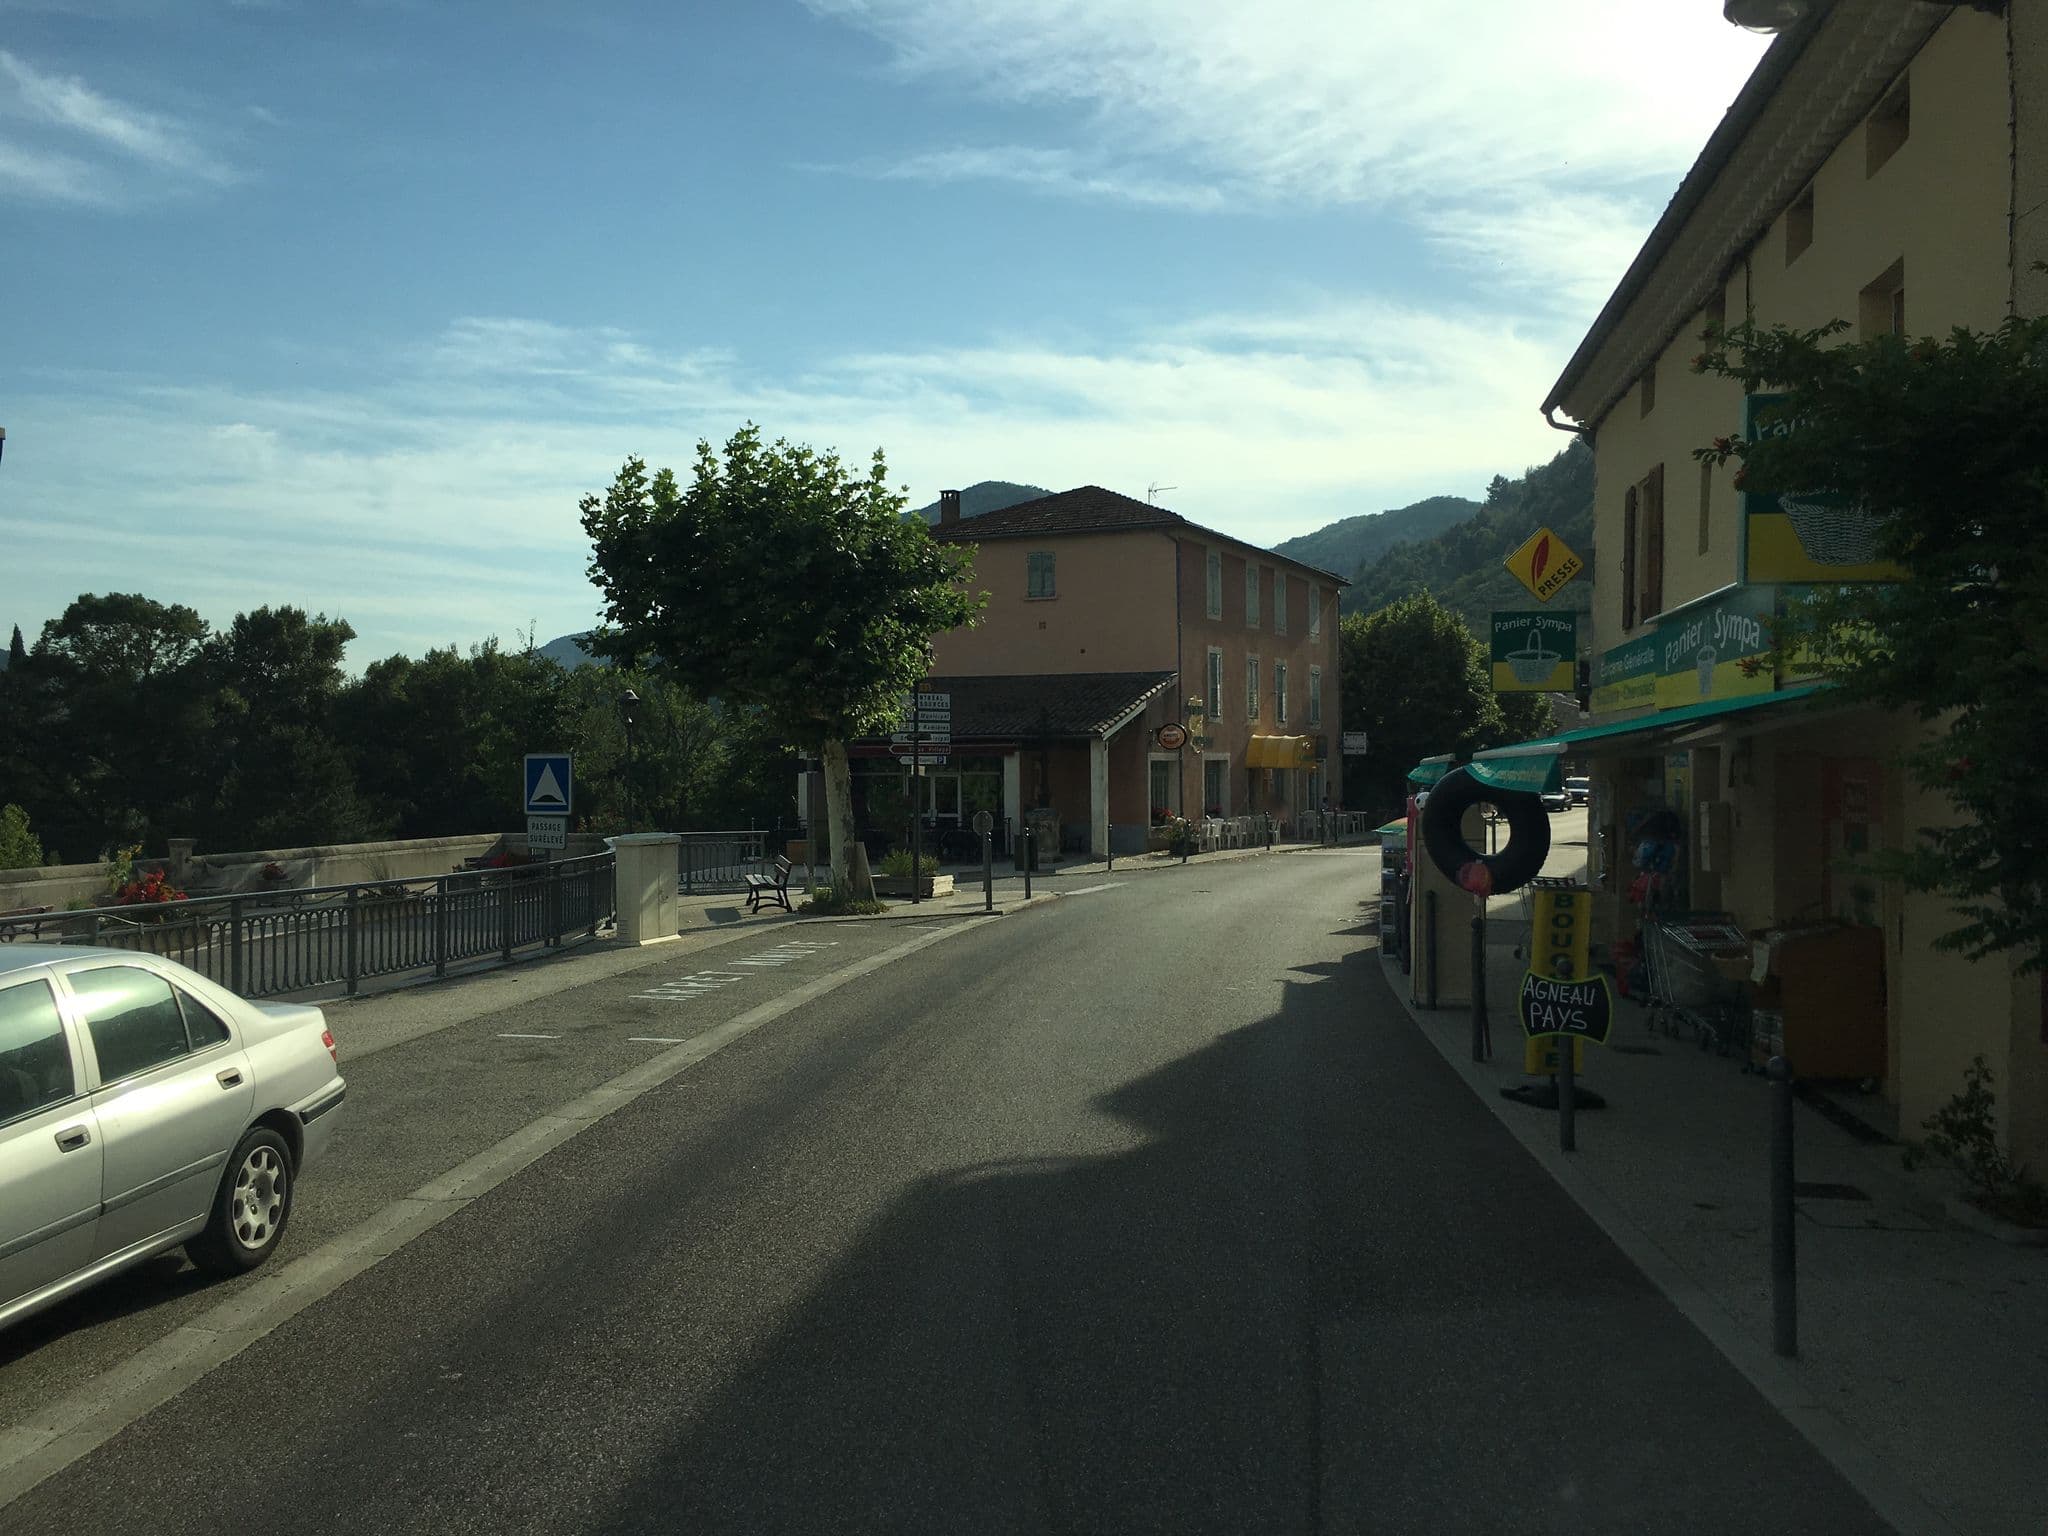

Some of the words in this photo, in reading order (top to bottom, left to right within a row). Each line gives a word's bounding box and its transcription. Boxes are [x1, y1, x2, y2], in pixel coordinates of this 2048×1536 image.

[1538, 557, 1578, 596] PRESSE
[1494, 616, 1532, 633] Panier
[1535, 615, 1573, 633] Sympa
[1665, 619, 1703, 672] Panier
[1713, 607, 1760, 653] Sympa
[531, 822, 561, 832] PASSAGE
[1523, 975, 1596, 1006] AGNEAU
[1529, 1002, 1588, 1031] PAYS
